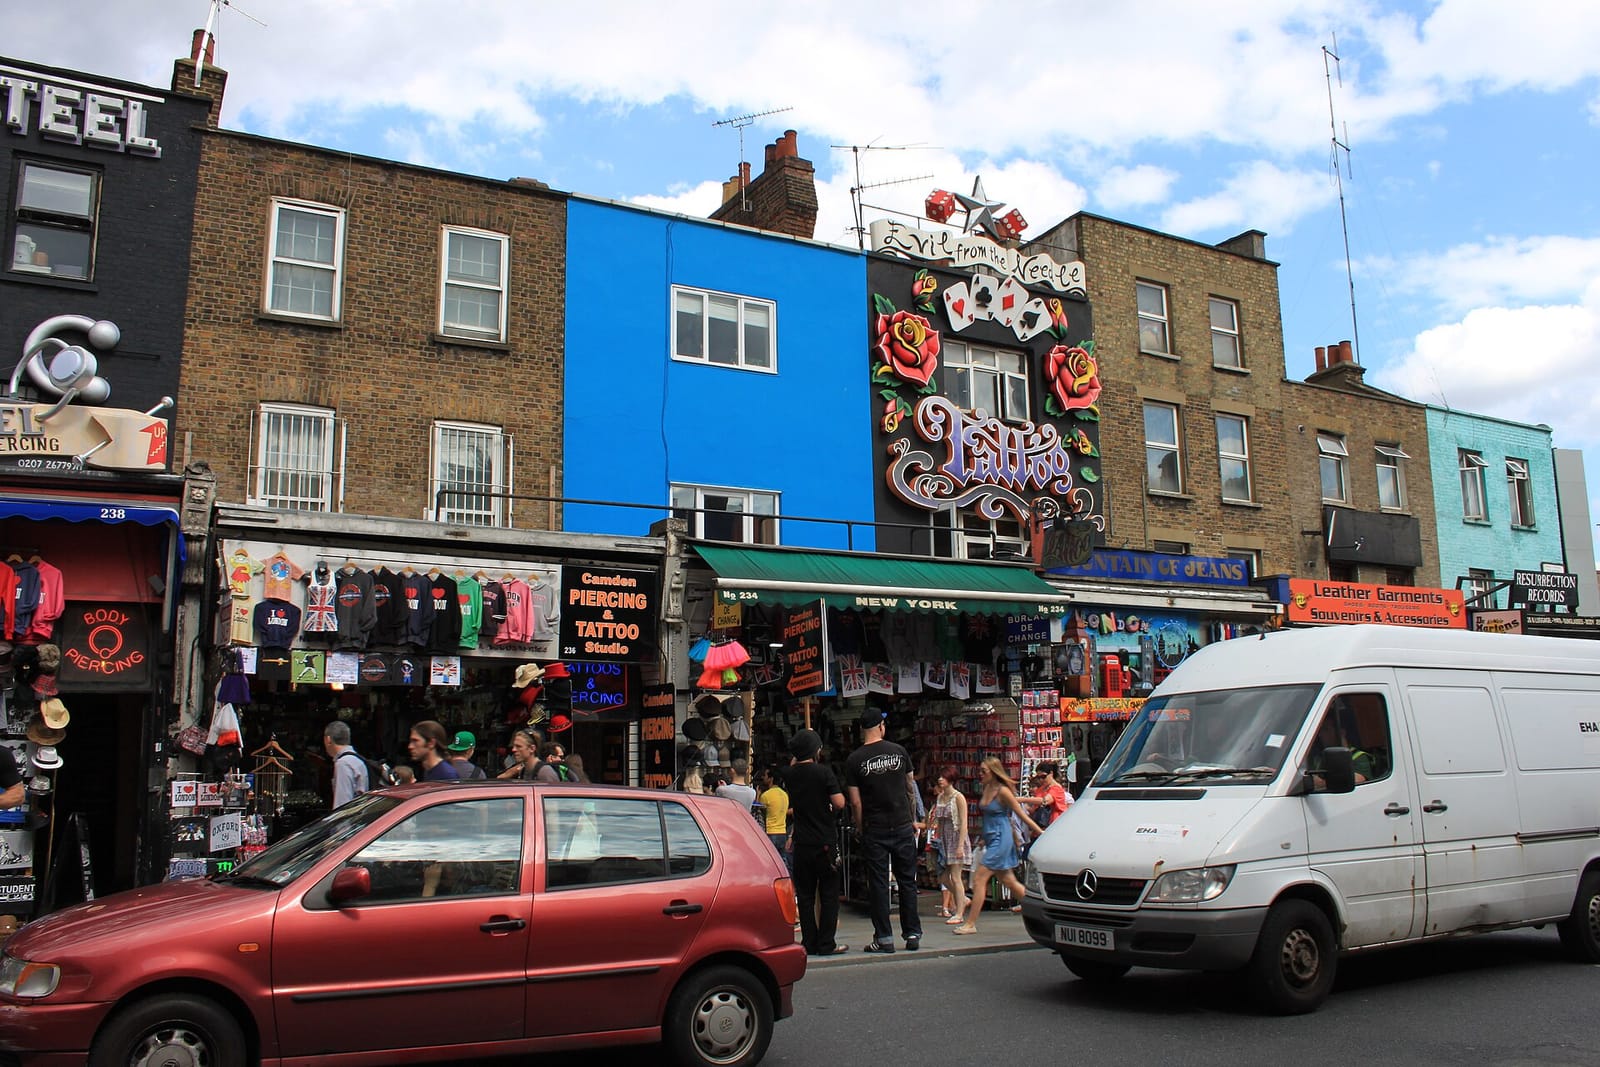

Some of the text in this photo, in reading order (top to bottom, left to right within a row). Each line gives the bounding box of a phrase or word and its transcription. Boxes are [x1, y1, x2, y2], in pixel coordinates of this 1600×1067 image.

[0, 75, 162, 158] TEEL
[883, 219, 1080, 287] Evil from the Needle
[154, 427, 166, 438] UP
[914, 396, 1073, 495] Tattoo
[18, 459, 42, 468] 0207
[100, 508, 125, 519] 238
[1158, 559, 1180, 575] OF
[1184, 561, 1243, 580] JEANS
[581, 572, 637, 587] Camden
[1516, 572, 1576, 588] RESURRECTION
[569, 588, 648, 610] PIERCING
[1314, 583, 1443, 604] Leather Garments
[1527, 589, 1565, 603] RECORDS
[724, 606, 730, 614] DE
[856, 597, 957, 610] NEW YORK
[83, 608, 130, 626] BODY
[602, 609, 614, 620] &
[718, 615, 737, 625] CHANGE
[790, 610, 813, 623] Camden
[1310, 608, 1449, 625] Souvenirs & Accessories
[576, 621, 640, 640] TATTOO
[784, 617, 820, 639] PIERCING
[1021, 624, 1033, 632] DE
[800, 636, 805, 647] &
[1008, 632, 1047, 643] CHANGE
[564, 646, 576, 655] 236
[585, 641, 629, 655] Studio
[64, 648, 145, 675] PIERCING
[788, 647, 818, 664] TATTOO
[586, 677, 595, 689] &
[571, 691, 624, 705] ERCING
[643, 691, 673, 708] Camden
[641, 716, 674, 740] PIERCING
[1579, 722, 1600, 733] EHA
[644, 774, 673, 788] TATTOO
[212, 822, 239, 836] OXFORD
[1061, 927, 1107, 946] NUI 8099
